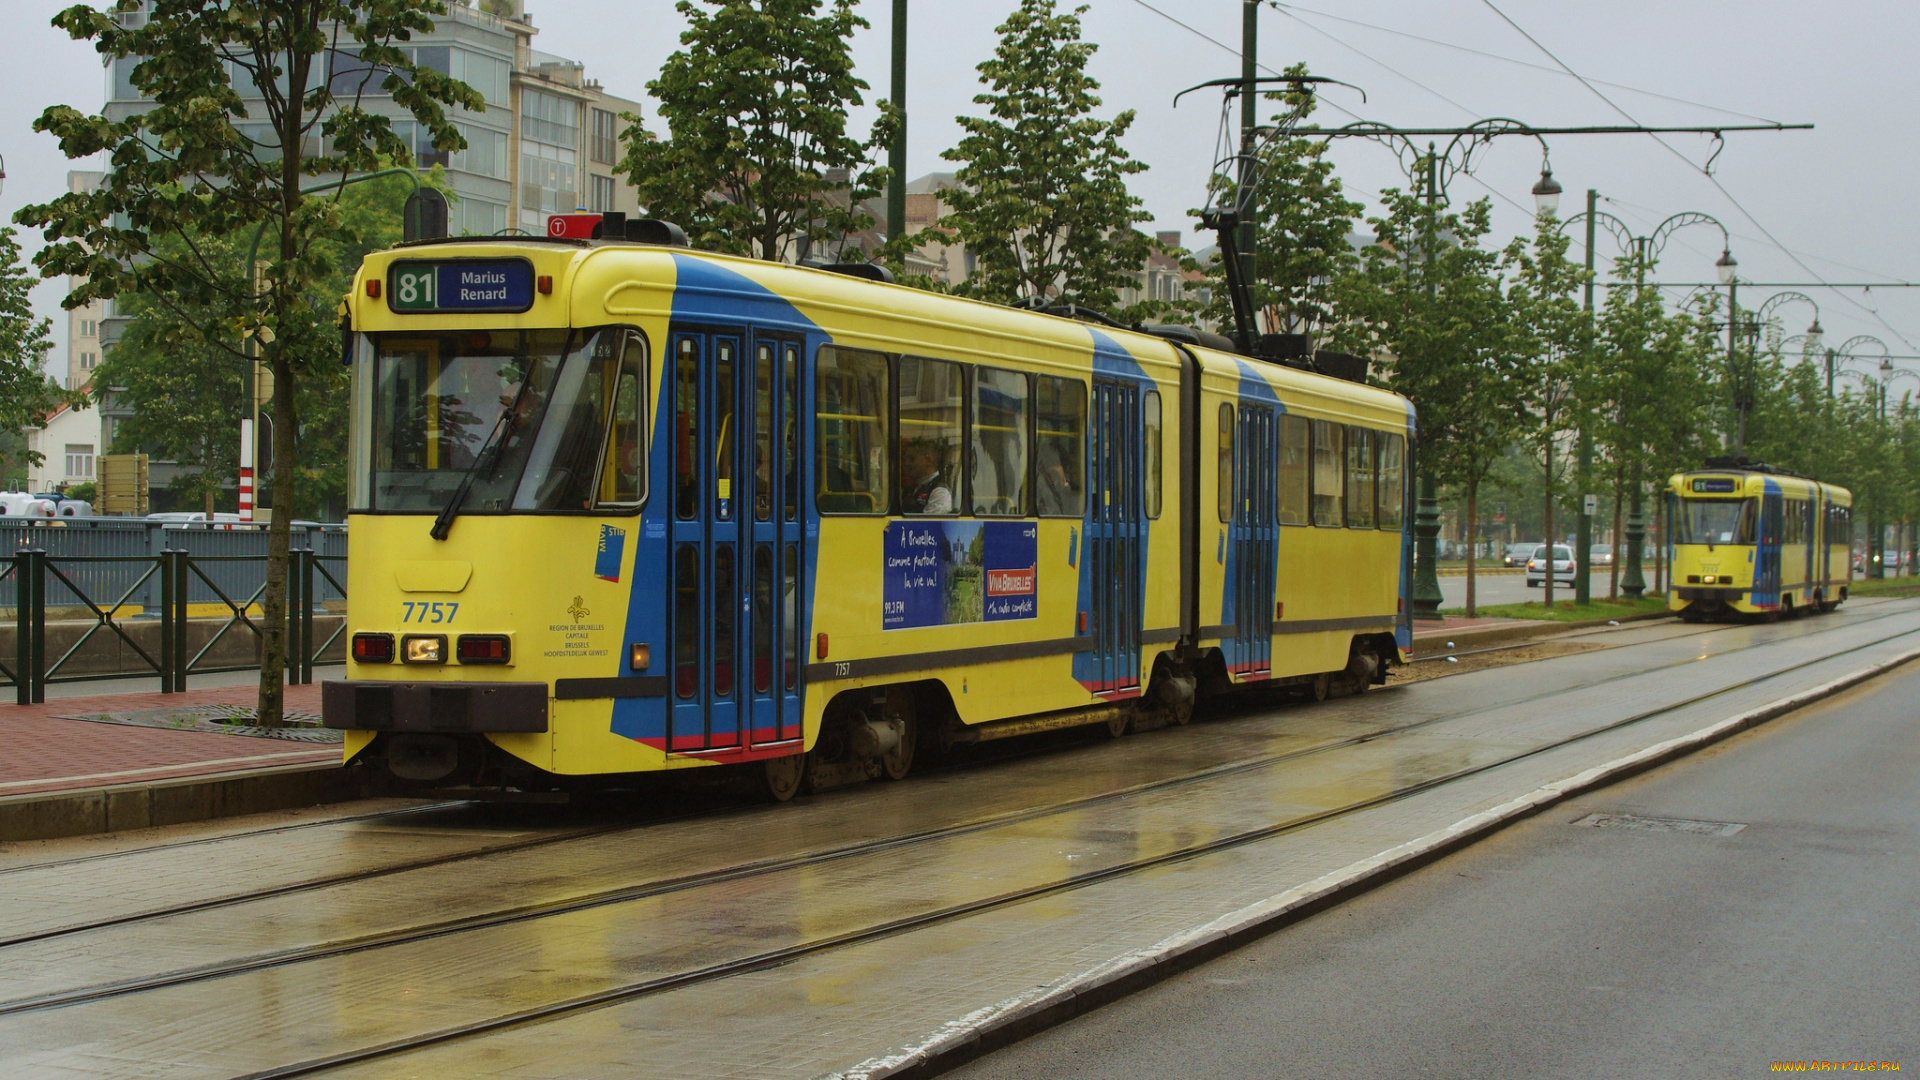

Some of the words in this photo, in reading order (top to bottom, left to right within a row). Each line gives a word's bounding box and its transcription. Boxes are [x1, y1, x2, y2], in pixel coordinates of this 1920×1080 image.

[554, 222, 562, 232] T
[461, 271, 506, 285] Marius
[399, 273, 432, 303] 81
[460, 287, 507, 301] Renard
[1694, 481, 1705, 491] 81
[608, 527, 625, 537] STIB
[900, 526, 906, 549] À
[888, 556, 911, 567] comme
[904, 571, 911, 589] la
[913, 574, 924, 587] vie
[926, 570, 937, 587] va!
[402, 601, 459, 624] 7757
[884, 601, 896, 614] 99.3
[896, 601, 904, 614] FM
[987, 601, 998, 615] Ma
[998, 599, 1010, 614] radio
[835, 662, 850, 676] 7757
